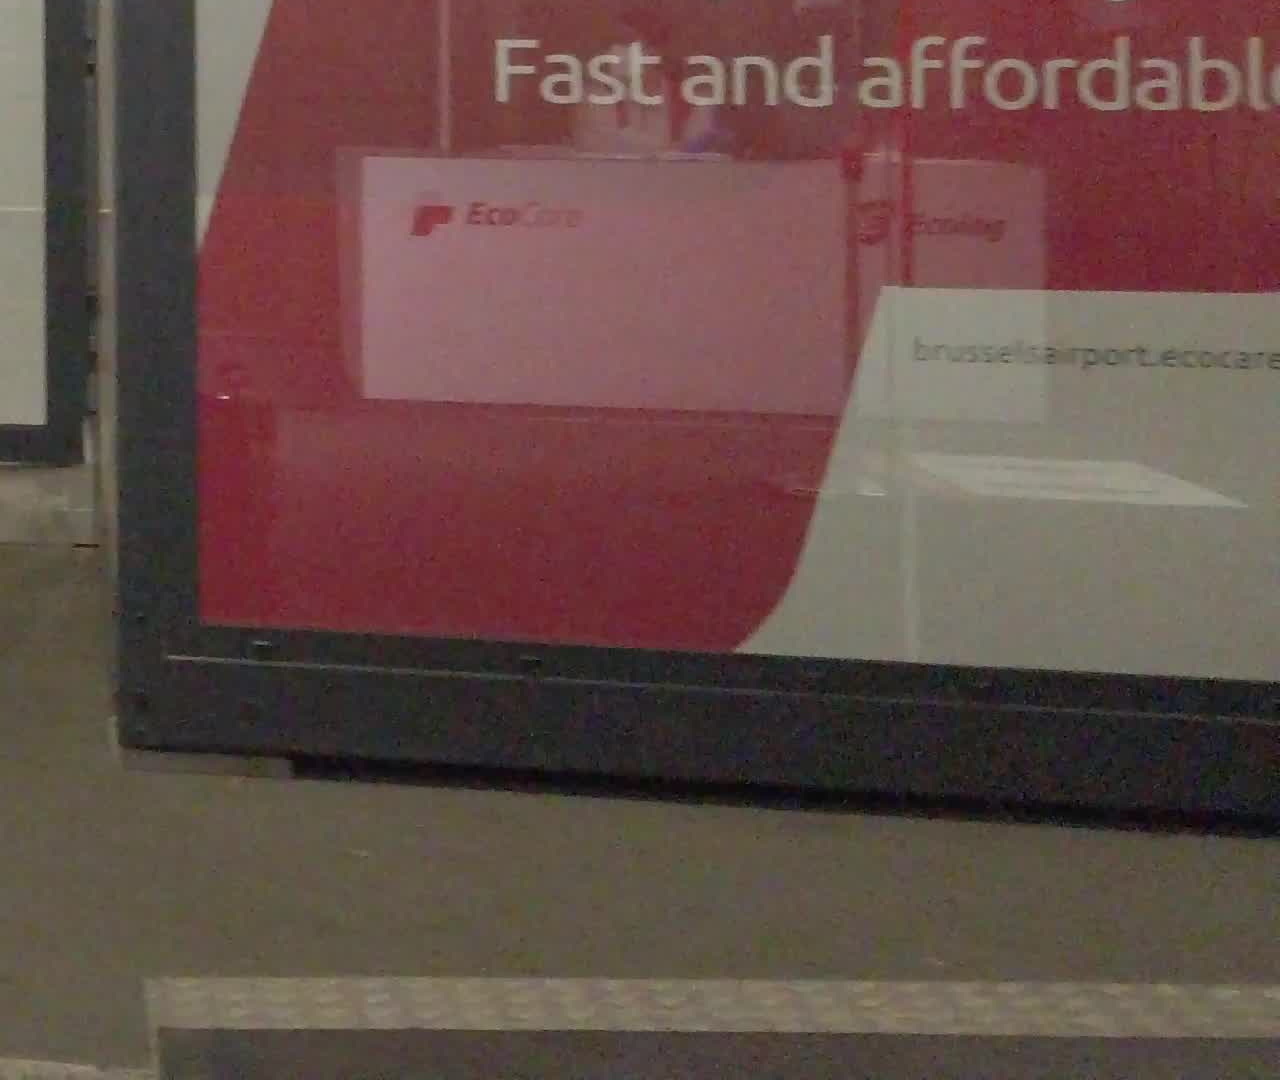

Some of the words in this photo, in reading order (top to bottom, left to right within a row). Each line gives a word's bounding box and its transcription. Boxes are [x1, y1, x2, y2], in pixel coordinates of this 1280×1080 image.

[494, 38, 665, 105] Fast
[680, 34, 835, 107] and
[858, 36, 1280, 111] affordabl
